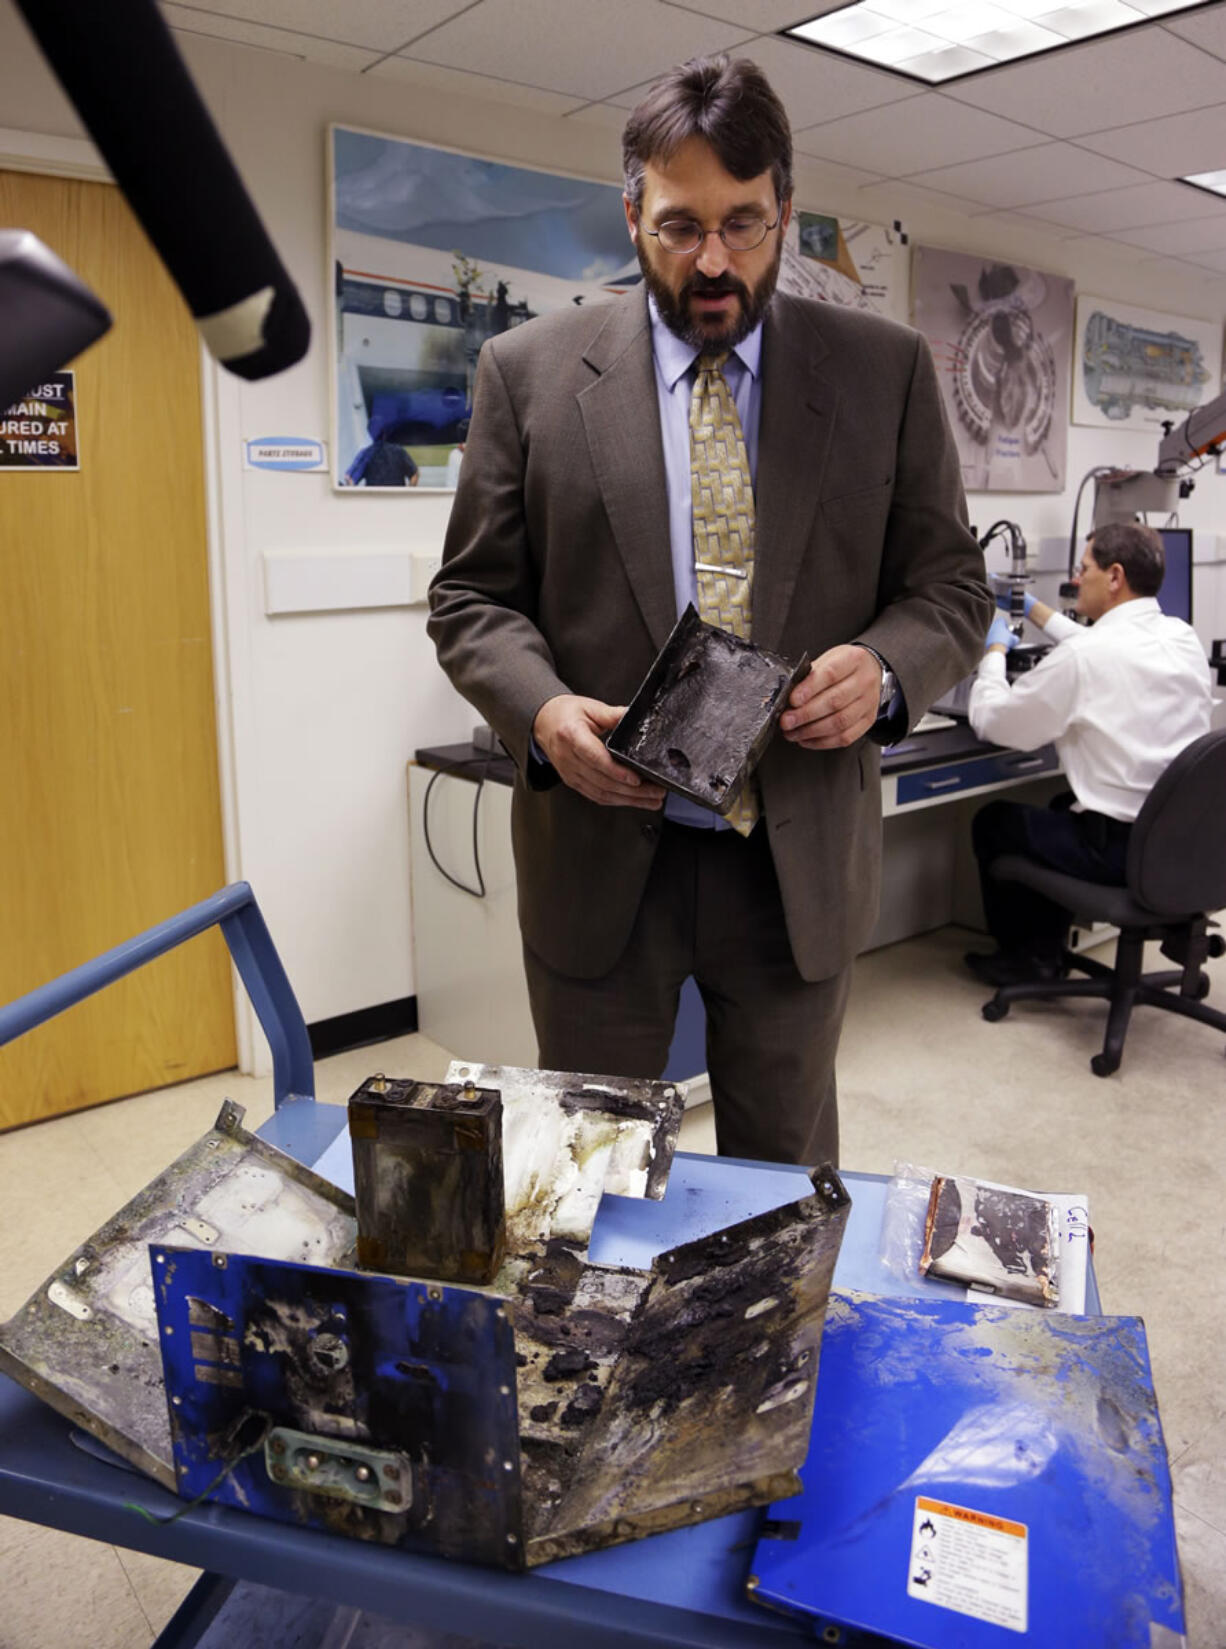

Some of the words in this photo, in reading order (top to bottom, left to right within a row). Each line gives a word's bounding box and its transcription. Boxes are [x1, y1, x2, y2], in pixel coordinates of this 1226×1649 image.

[26, 384, 64, 398] UST
[47, 422, 68, 436] AT
[6, 440, 60, 455] TIMES
[954, 1510, 1005, 1531] WARNING
